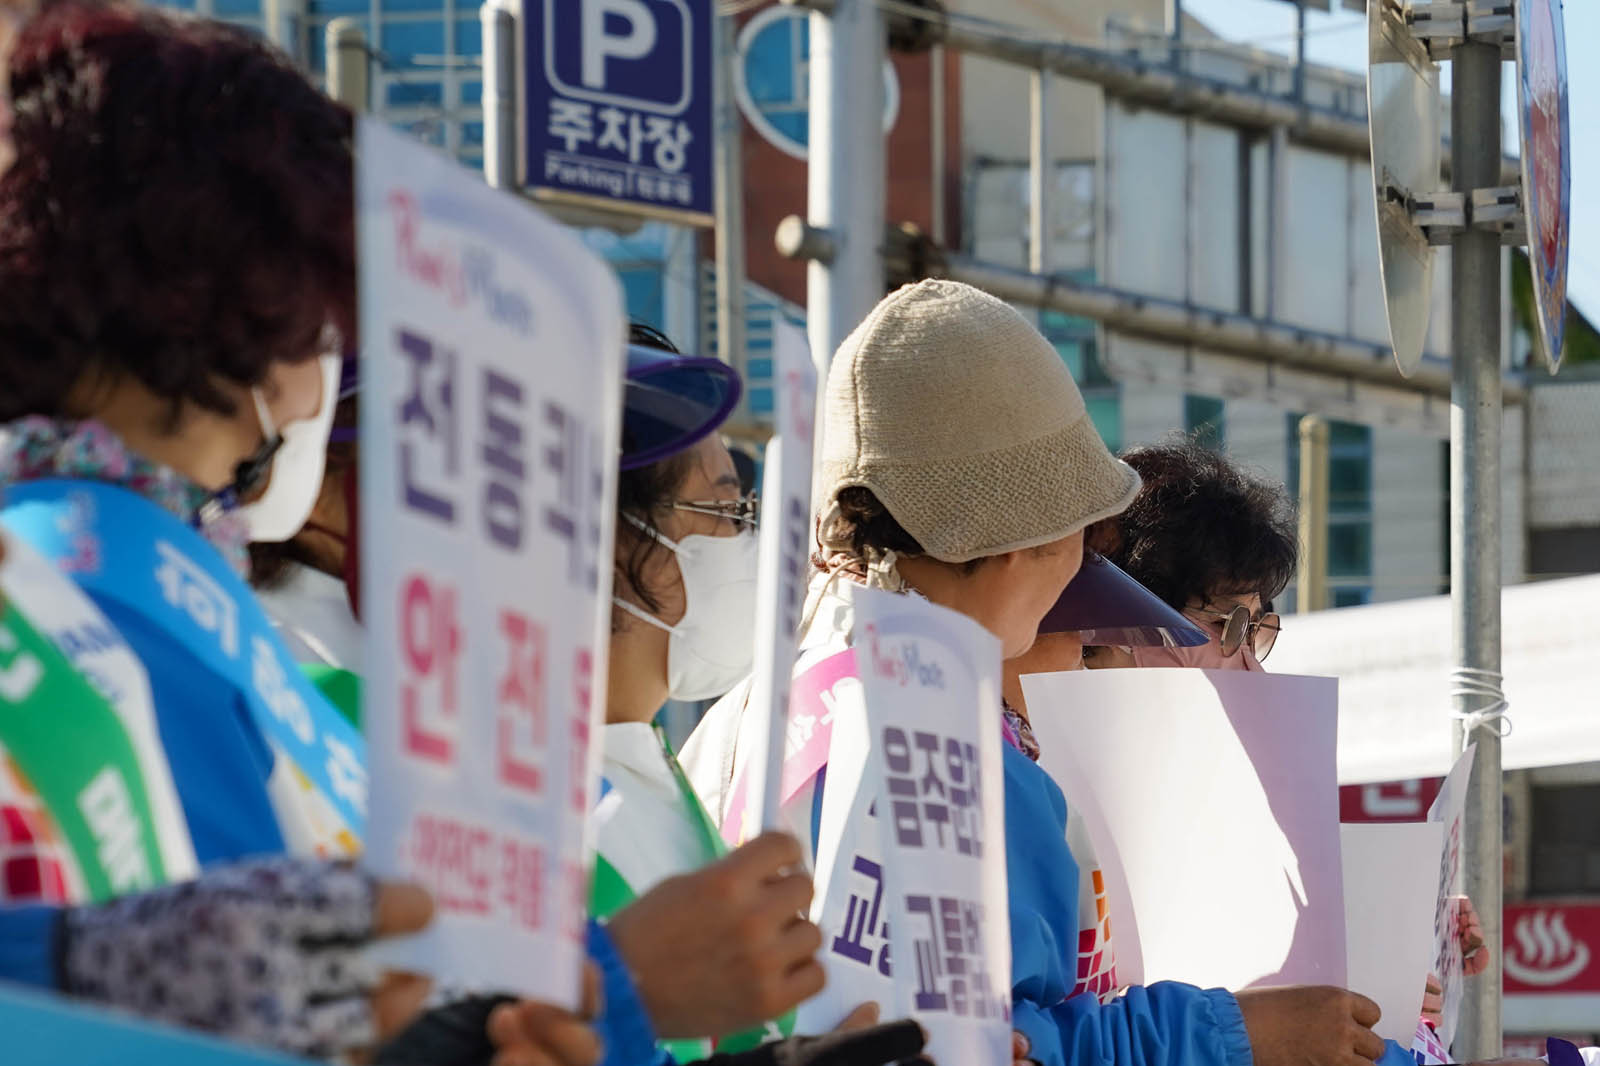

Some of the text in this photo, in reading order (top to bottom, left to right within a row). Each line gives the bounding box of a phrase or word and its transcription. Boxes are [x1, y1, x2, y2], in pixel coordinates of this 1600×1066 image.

[581, 0, 657, 89] P
[549, 98, 692, 173] 주차장
[545, 156, 625, 197] Parking
